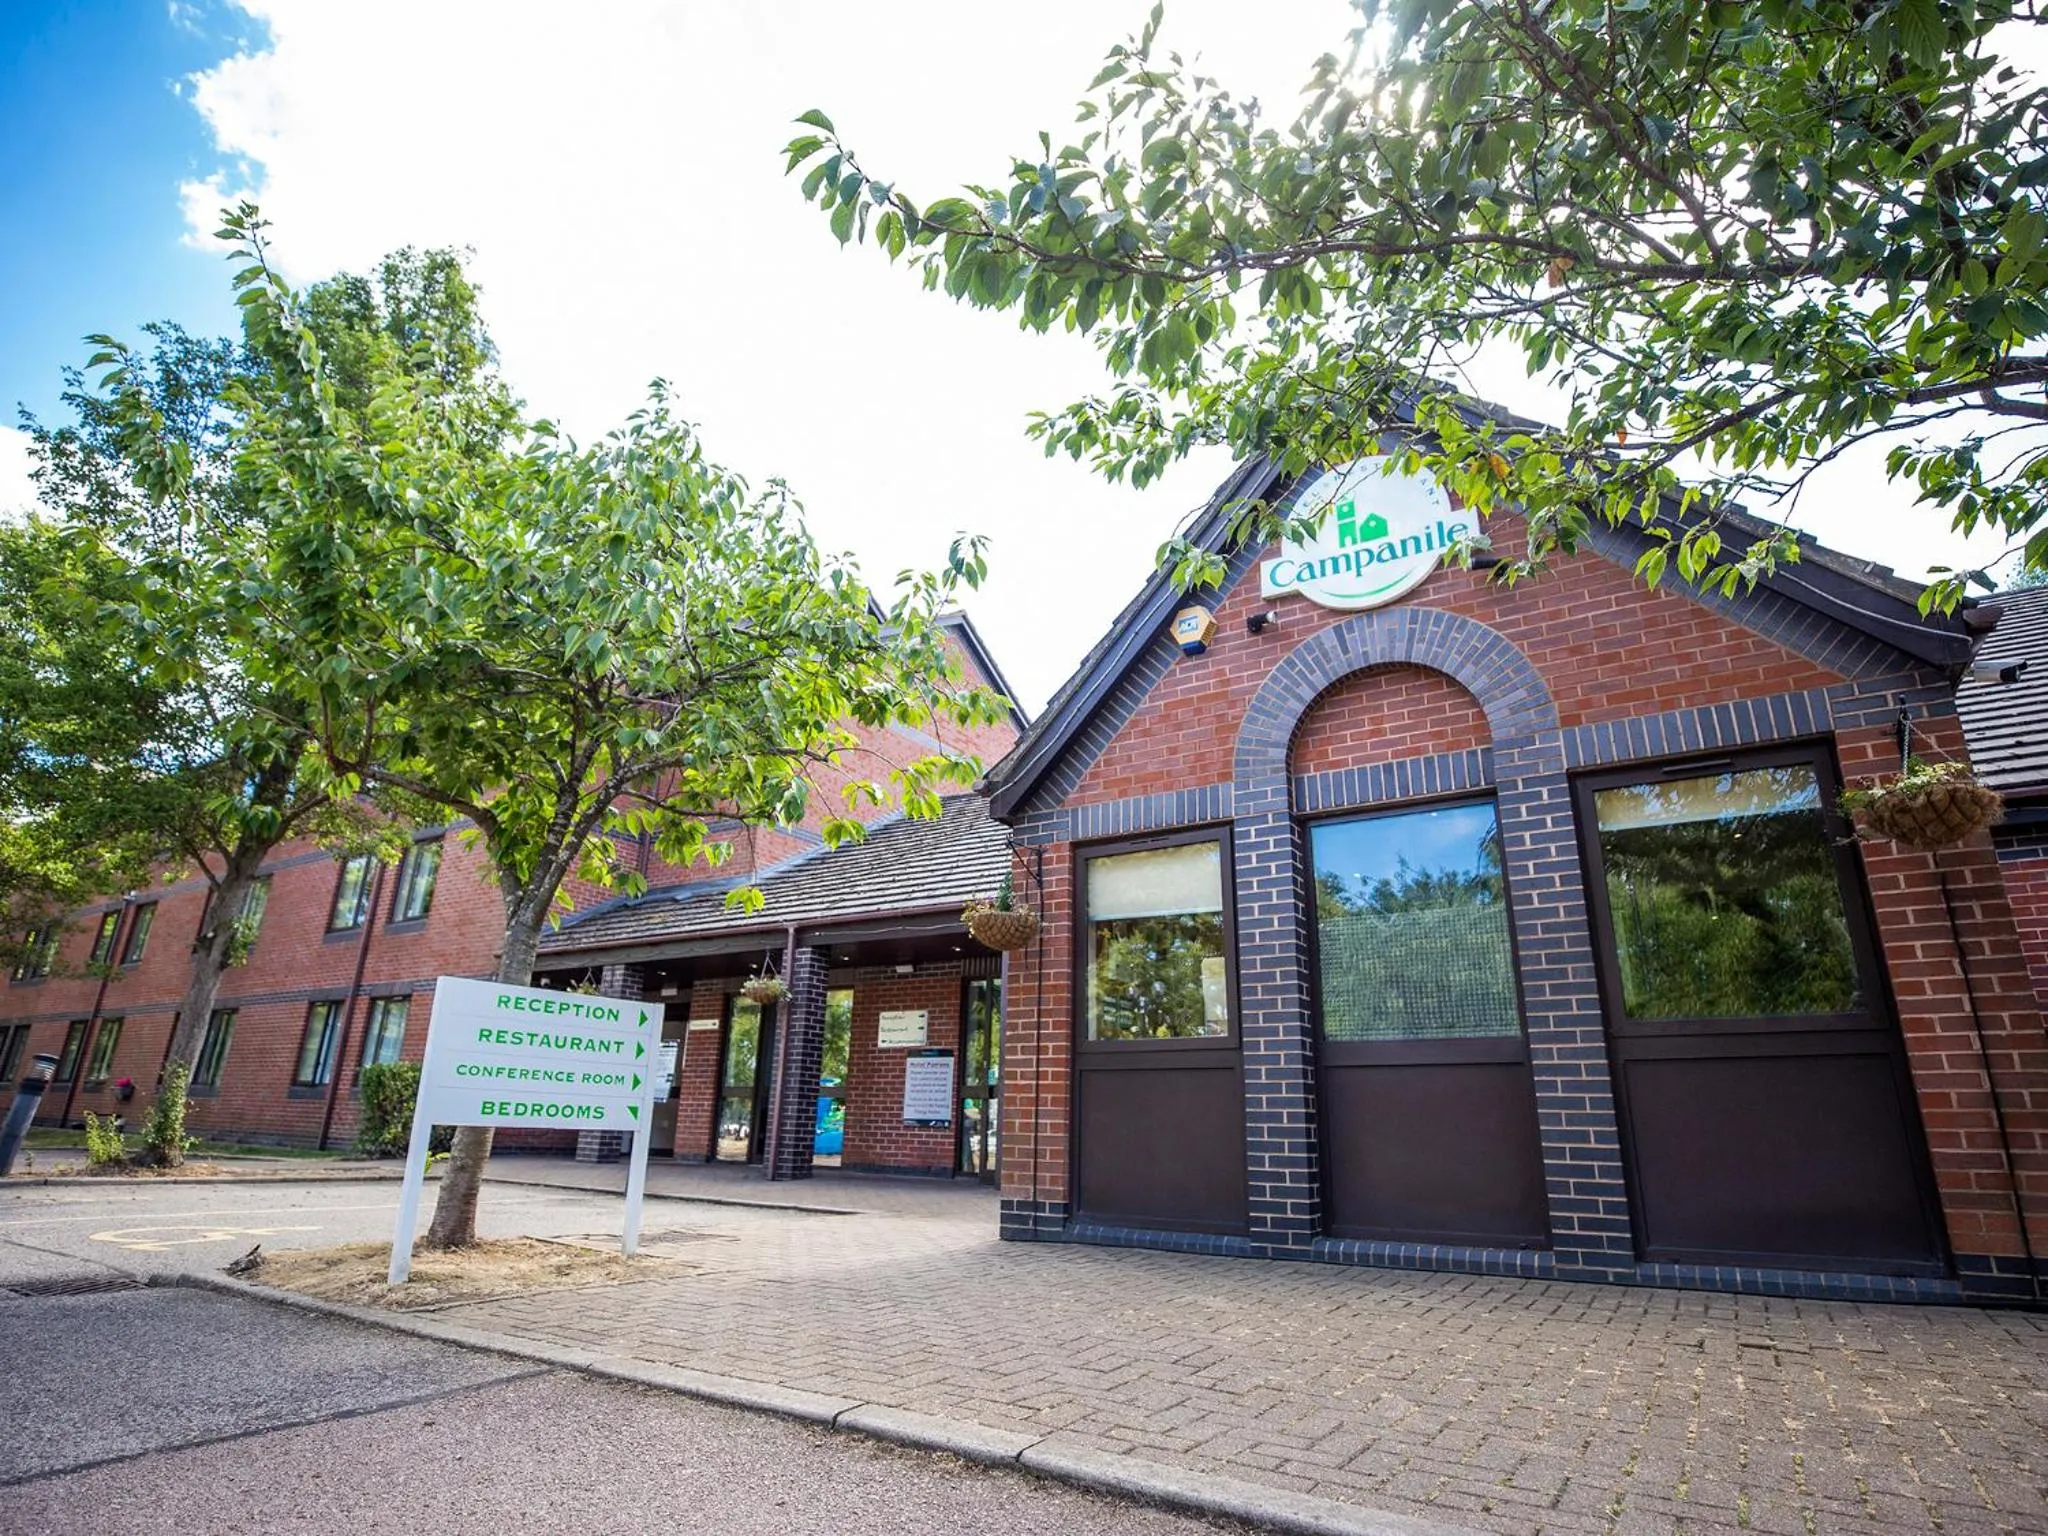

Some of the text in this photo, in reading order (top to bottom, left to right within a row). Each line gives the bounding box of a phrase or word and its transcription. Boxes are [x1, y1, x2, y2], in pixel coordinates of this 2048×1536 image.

[1269, 520, 1469, 588] Campanile
[496, 995, 620, 1022] RECEPTION
[478, 1028, 624, 1054] RESTAURANT
[456, 1064, 625, 1086] CONFERENCE ROOM
[480, 1101, 605, 1120] BEDROOMS
